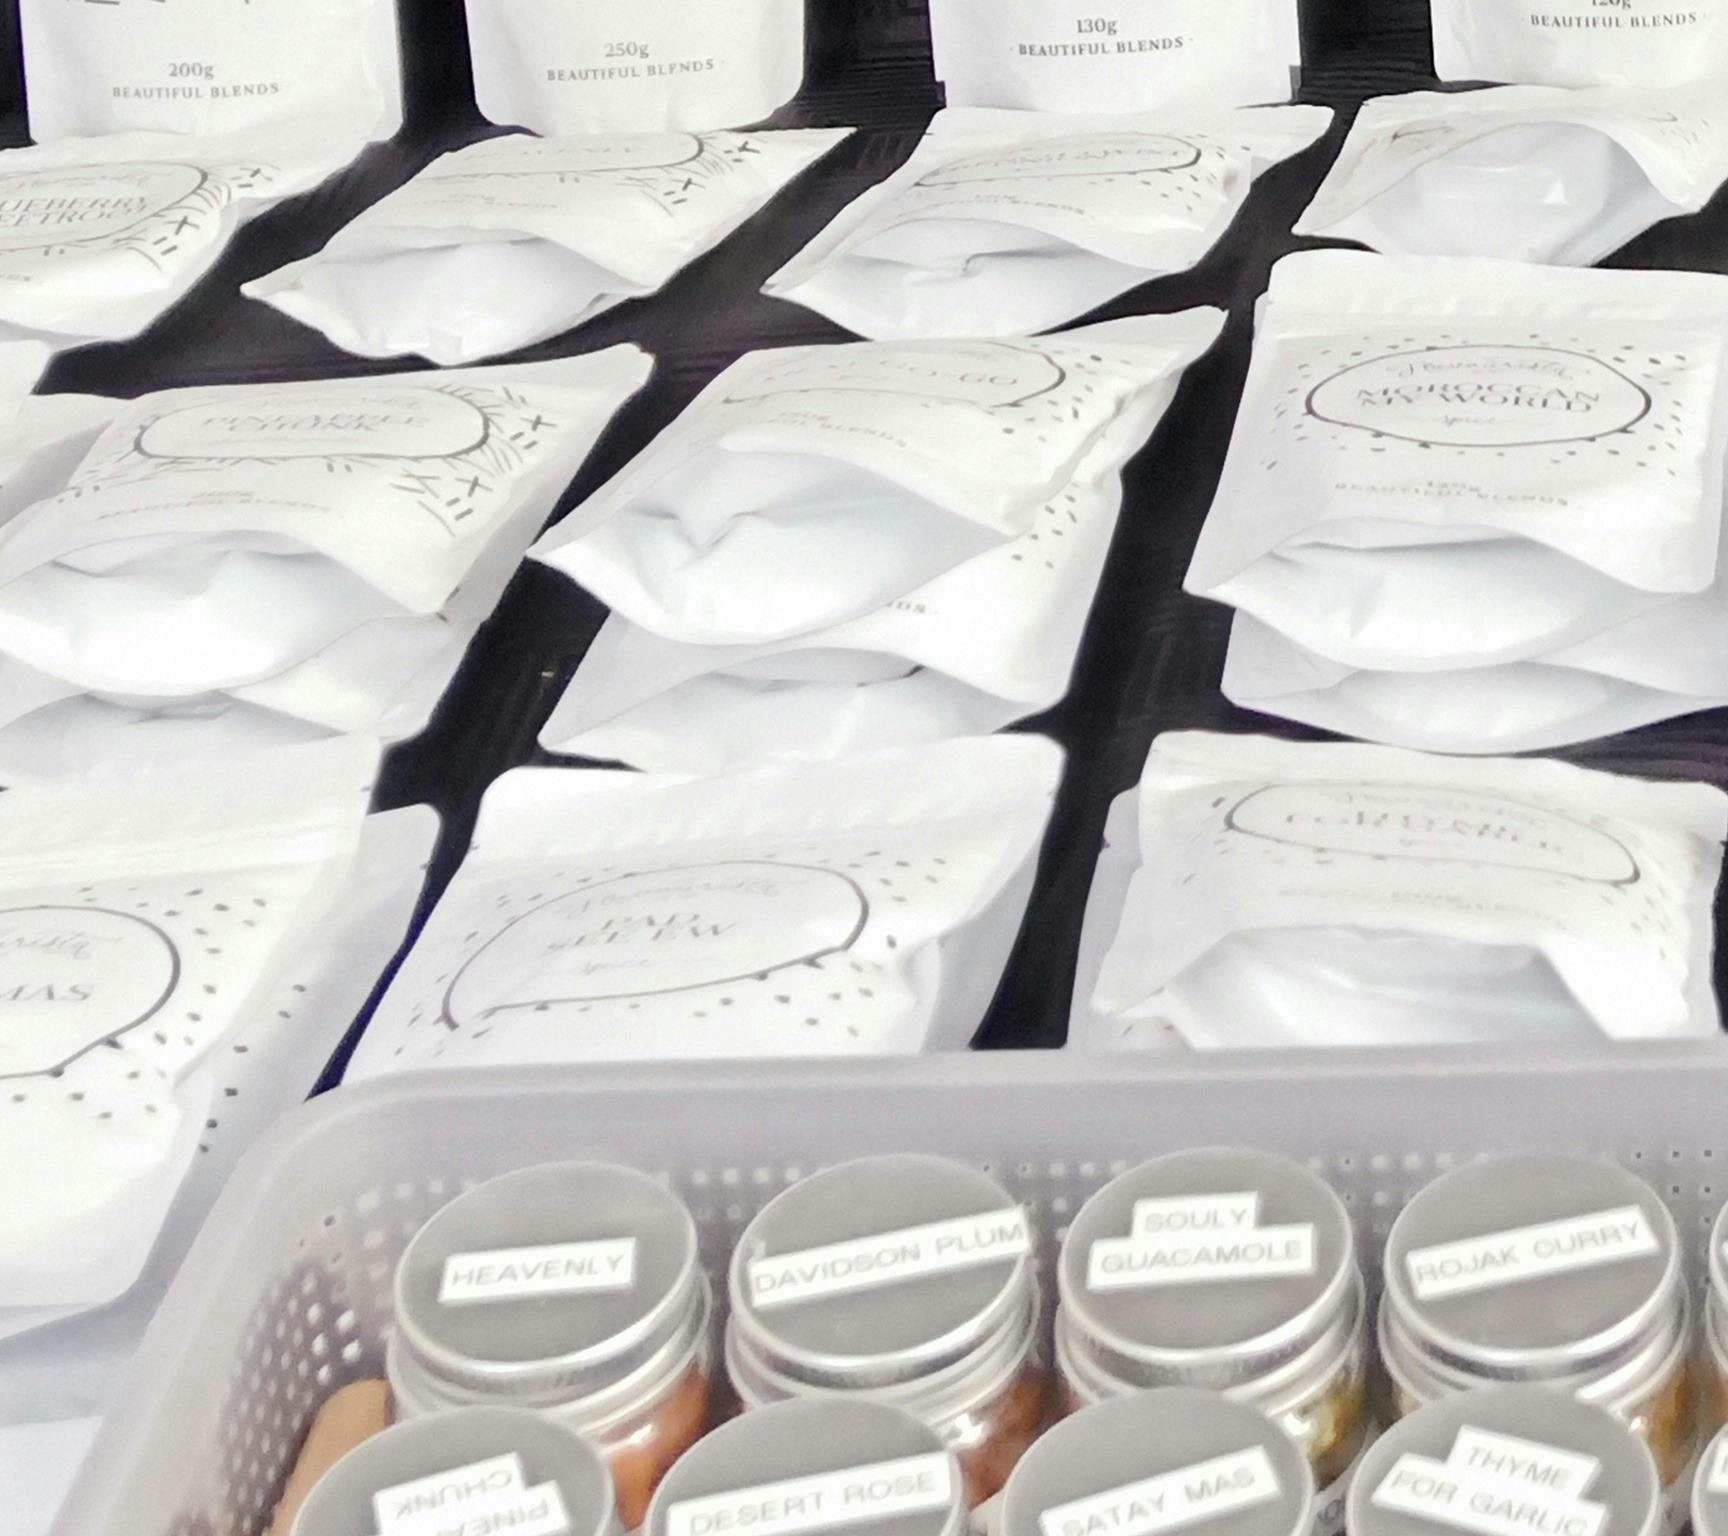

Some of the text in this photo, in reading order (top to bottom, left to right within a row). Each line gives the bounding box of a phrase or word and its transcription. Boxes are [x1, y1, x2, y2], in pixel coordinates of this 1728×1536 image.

[1076, 18, 1118, 35] 130g
[1529, 11, 1698, 28] BEAUTIFUL BLENDS
[604, 41, 650, 60] 250g
[1018, 36, 1185, 57] BEAUTIFUL BLENDS
[168, 62, 215, 81] 200g
[546, 58, 715, 83] BEAUTIFUL BLENDS
[112, 82, 281, 100] BEAUTIFUL BLENDS
[1144, 1206, 1252, 1232] SOULY
[752, 1220, 1025, 1295] DAVIDSON PLUM
[1102, 1238, 1304, 1275] GUACAMOLE
[1415, 1220, 1641, 1285] ROJAK CURRY
[452, 1252, 627, 1287] HEAVENLY
[1466, 1444, 1571, 1489] THYME
[1183, 1466, 1257, 1503] MAS
[690, 1470, 938, 1535] DESERT ROSE
[1391, 1470, 1589, 1536] FOR GARLIC
